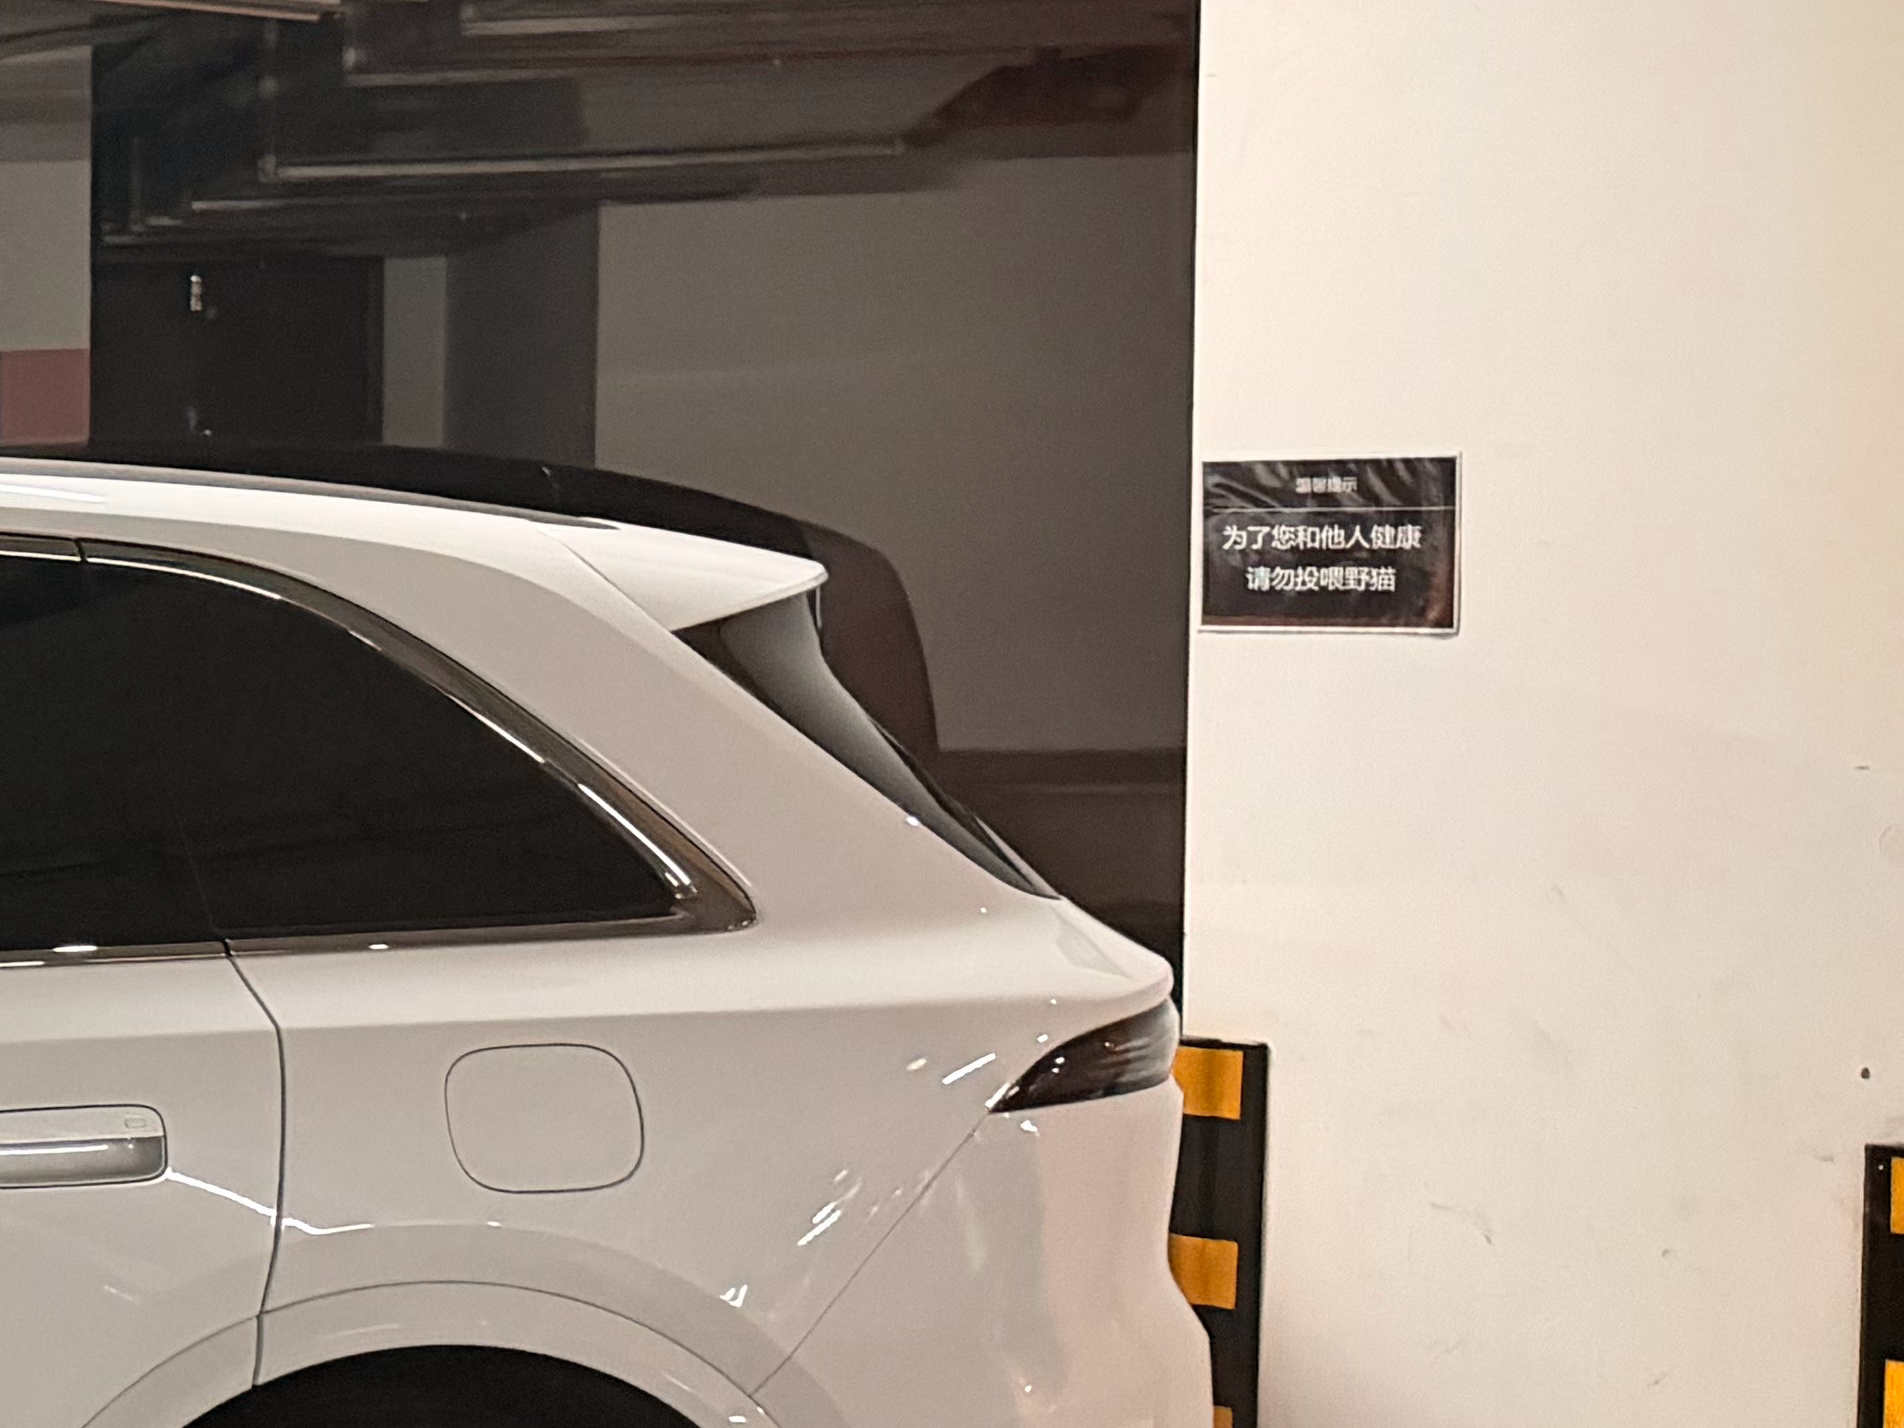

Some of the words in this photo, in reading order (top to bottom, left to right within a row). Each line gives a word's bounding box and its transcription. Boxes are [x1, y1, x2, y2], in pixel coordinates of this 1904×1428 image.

[1222, 524, 1423, 550] 为了您和他人健康
[1245, 566, 1397, 592] 请勿投喂野猫
